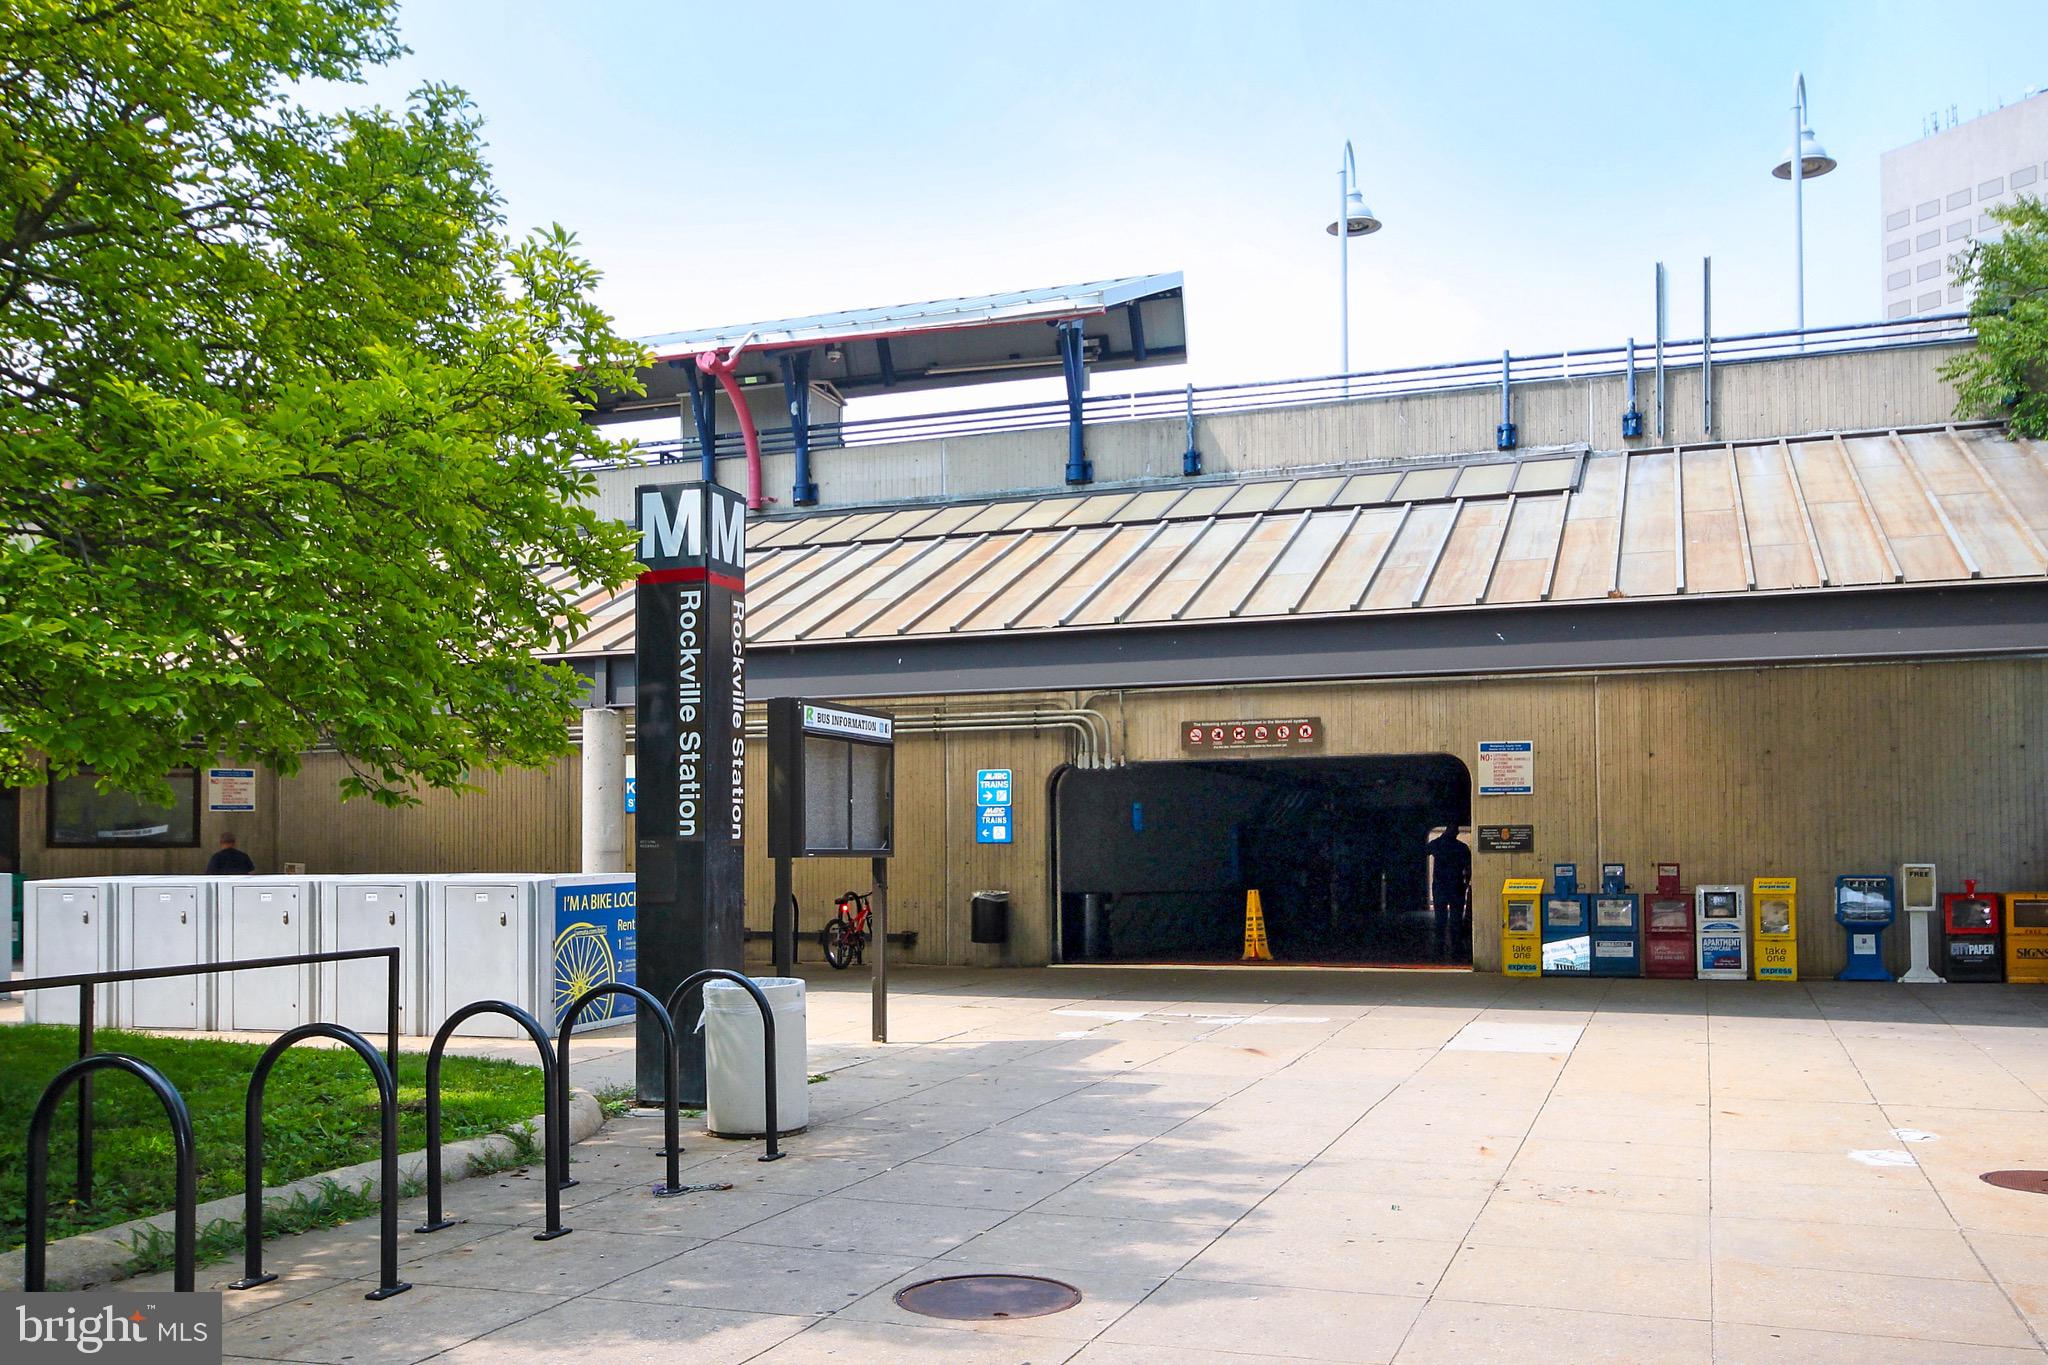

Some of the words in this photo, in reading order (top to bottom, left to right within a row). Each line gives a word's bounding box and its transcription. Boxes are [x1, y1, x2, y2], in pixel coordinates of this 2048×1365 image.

[642, 489, 701, 559] M
[712, 492, 744, 568] M
[680, 590, 701, 722] Rockville
[732, 600, 744, 729] Rockville
[817, 713, 830, 725] BUS
[831, 715, 876, 731] INFORMATION
[679, 732, 701, 836] Station
[732, 738, 744, 839] Station
[980, 780, 1008, 788] TRAINS
[628, 799, 636, 807] S
[563, 895, 580, 912] I'M
[581, 894, 589, 911] A
[590, 893, 612, 910] BIKE
[614, 891, 636, 908] LOC
[617, 918, 636, 931] Rent
[1512, 944, 1532, 952] take
[1703, 939, 1740, 947] APARTMENT
[1765, 947, 1787, 955] take
[617, 961, 622, 972] 2
